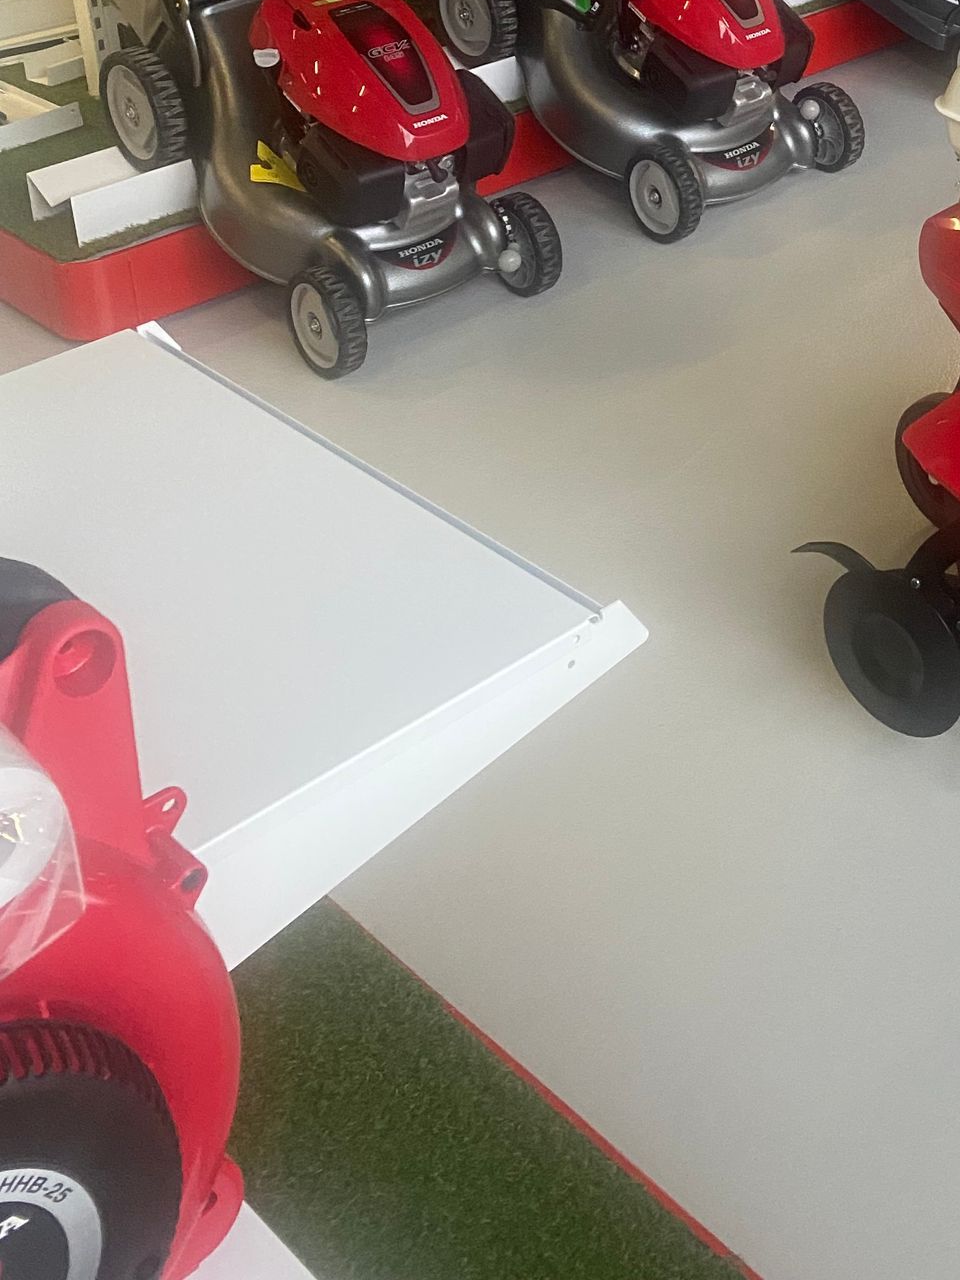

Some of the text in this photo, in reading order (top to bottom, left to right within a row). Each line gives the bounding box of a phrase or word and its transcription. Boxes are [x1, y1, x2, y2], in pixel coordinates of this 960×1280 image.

[745, 28, 772, 41] HONDA
[413, 114, 449, 129] HONDA
[724, 141, 760, 159] HONDA
[398, 238, 444, 258] HONDA
